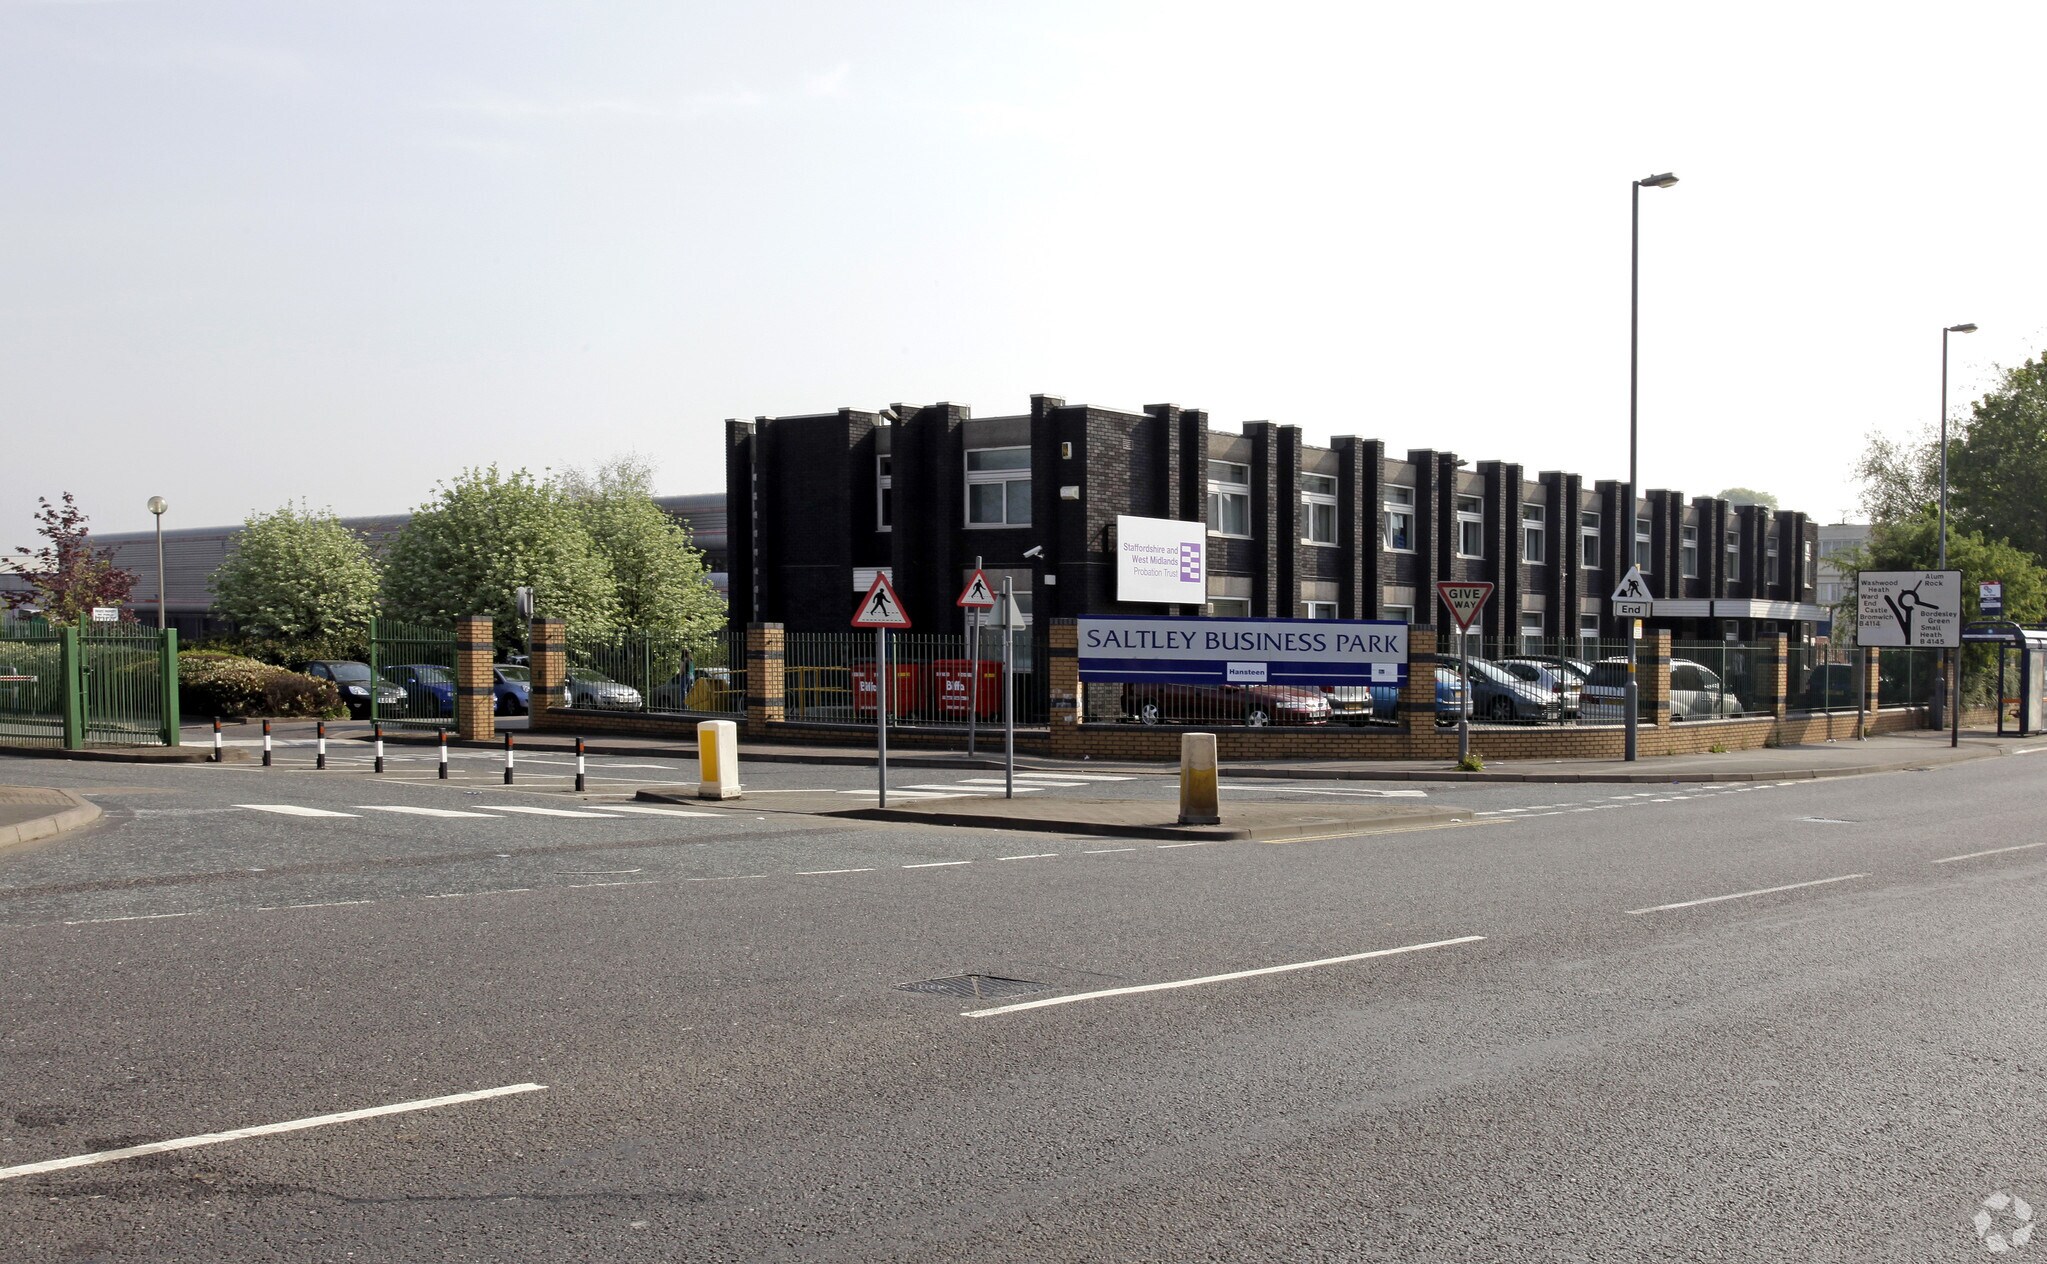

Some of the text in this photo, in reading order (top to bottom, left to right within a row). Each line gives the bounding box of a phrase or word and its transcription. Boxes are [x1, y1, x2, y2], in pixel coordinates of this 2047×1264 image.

[1123, 542, 1165, 554] Staffordshire
[1132, 555, 1178, 566] West Midlands
[1134, 566, 1178, 578] Probation Trust
[1449, 588, 1480, 598] GIVE
[1455, 600, 1476, 608] WAY
[1622, 605, 1640, 614] End
[1086, 629, 1399, 653] SALTLEY BUSINESS PARK
